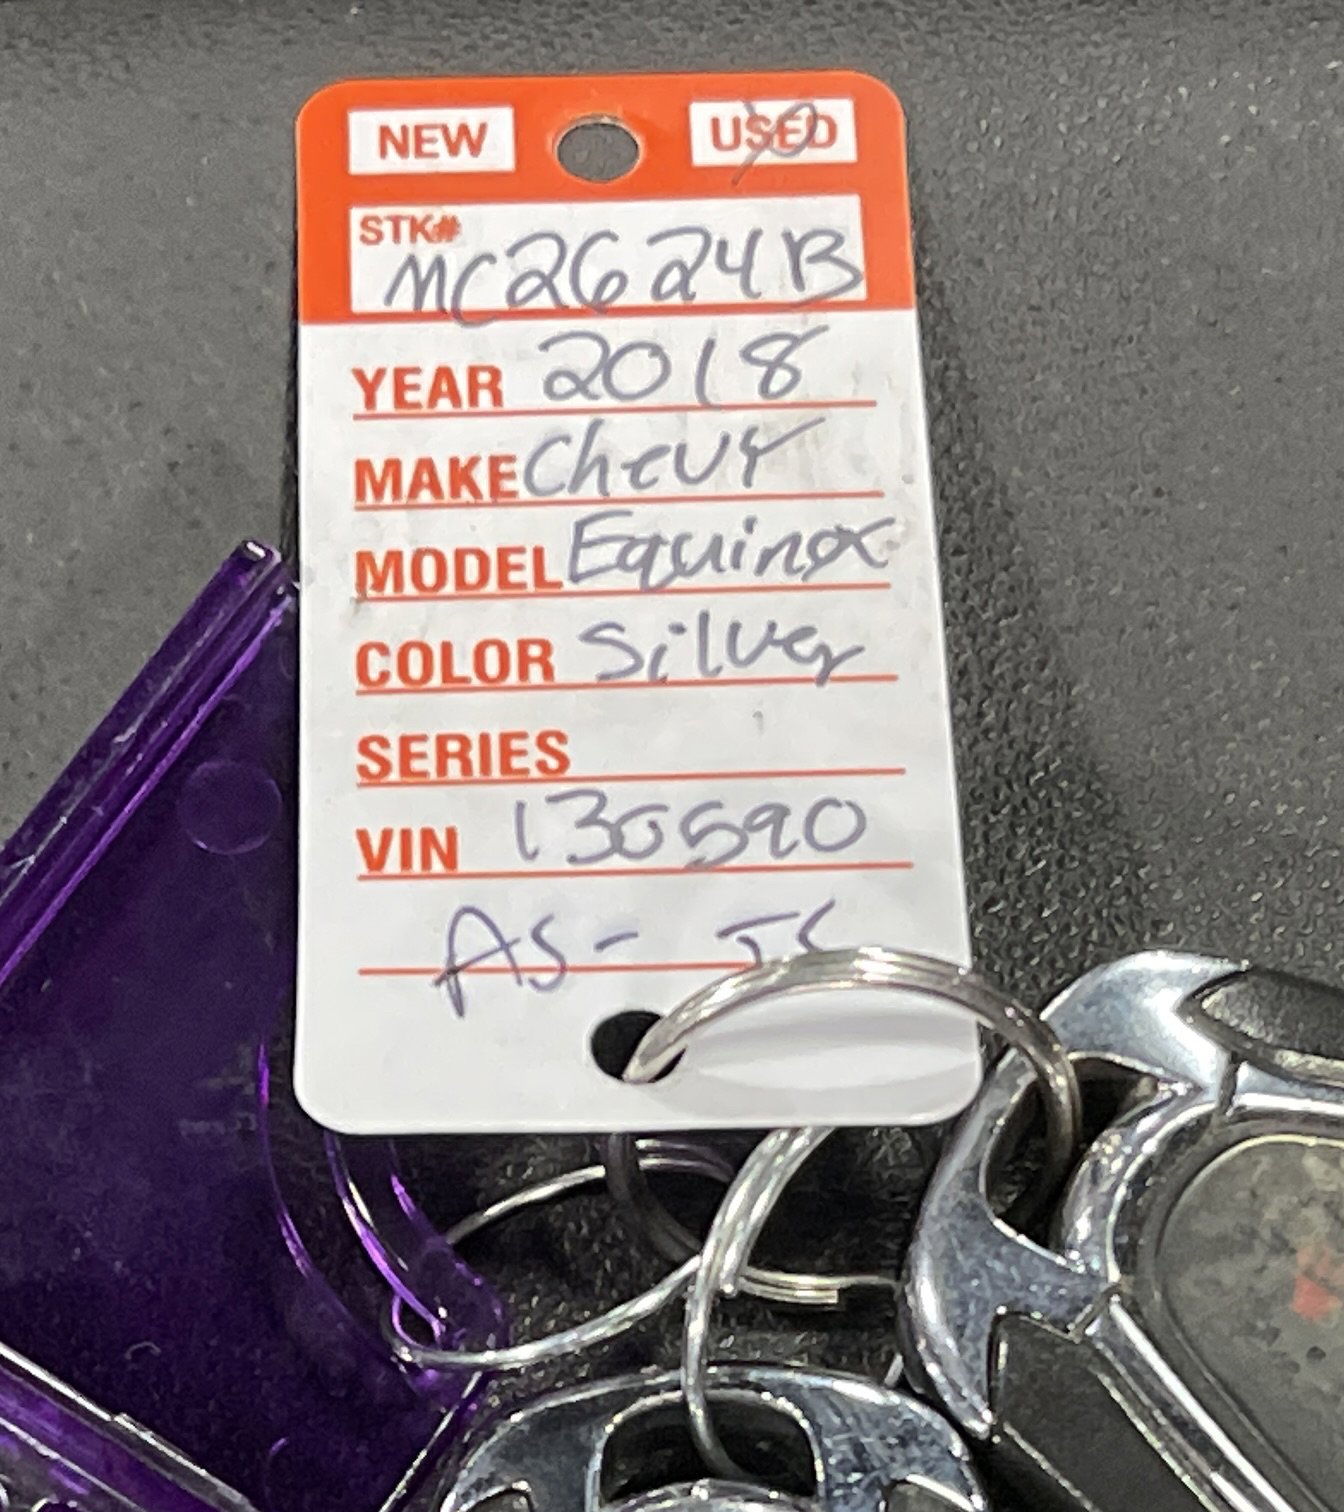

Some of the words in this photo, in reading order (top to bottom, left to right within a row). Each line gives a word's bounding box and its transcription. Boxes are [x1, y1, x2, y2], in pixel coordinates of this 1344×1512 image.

[378, 122, 488, 161] NEW
[710, 112, 838, 153] USED
[358, 214, 462, 246] STK#
[383, 224, 864, 328] MC2624B
[352, 364, 504, 410] YEAR
[538, 325, 829, 411] 2018
[355, 454, 518, 502] MAKE
[355, 544, 564, 596] MODEL
[568, 509, 896, 592] Equinox
[355, 637, 556, 689] COLOR
[355, 730, 571, 782] SERIES
[355, 825, 458, 873] VIN
